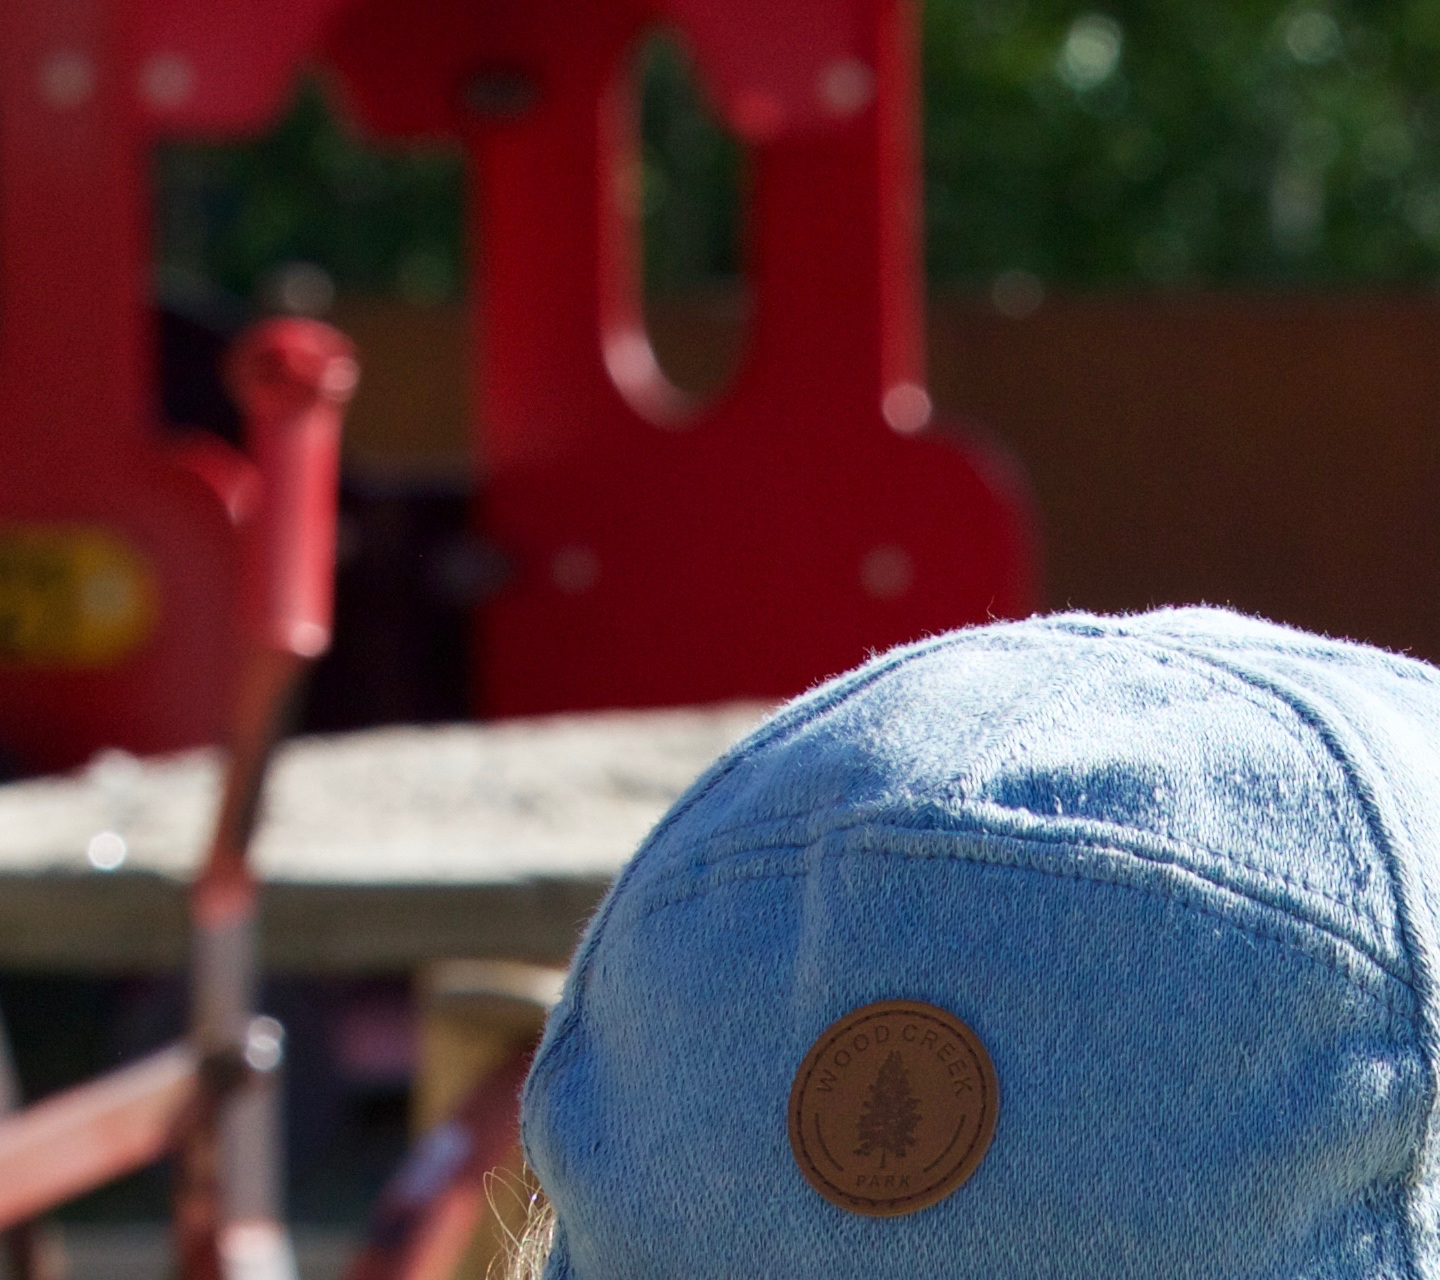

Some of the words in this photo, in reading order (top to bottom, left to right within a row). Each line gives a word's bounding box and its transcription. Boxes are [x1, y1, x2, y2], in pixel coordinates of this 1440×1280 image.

[817, 1025, 889, 1093] WOOD
[903, 1025, 973, 1096] CREEK
[857, 1174, 911, 1188] PARK
